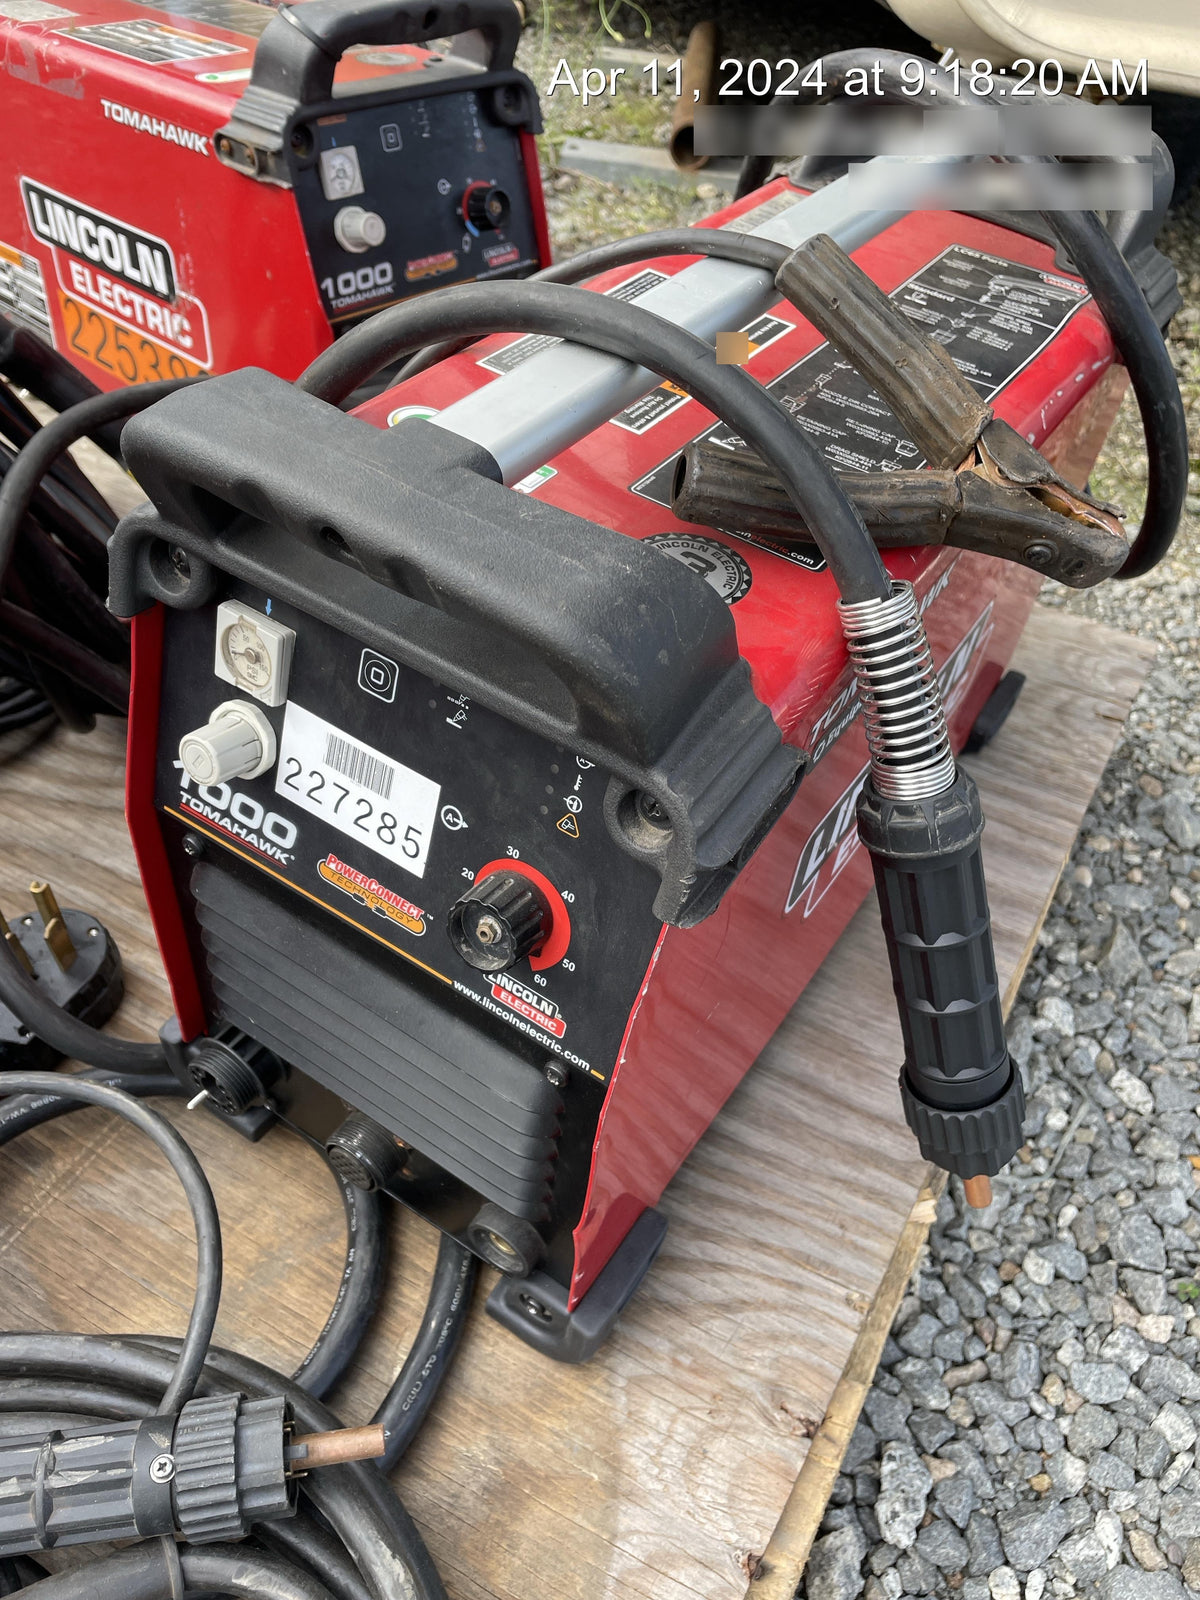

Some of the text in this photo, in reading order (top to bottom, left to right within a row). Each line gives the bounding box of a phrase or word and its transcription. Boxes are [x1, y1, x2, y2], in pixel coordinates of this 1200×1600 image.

[100, 99, 210, 156] TOMAHAWK
[29, 190, 171, 296] LINCOLN
[321, 261, 394, 299] 1000
[68, 259, 194, 349] ELECTRIC
[656, 541, 710, 553] INCOLN
[172, 759, 298, 850] 1000
[283, 757, 423, 860] 227285
[180, 791, 289, 867] TOMAHAWK
[461, 867, 475, 881] 20
[506, 846, 520, 859] 30
[329, 871, 414, 925] TECHNOLOGY
[560, 890, 576, 903] 40
[533, 974, 547, 987] 60
[562, 958, 576, 972] 50
[488, 972, 554, 1017] LINCOLN
[499, 991, 558, 1032] ELECTRIC
[453, 980, 591, 1071] www.lincolnelectric.com
